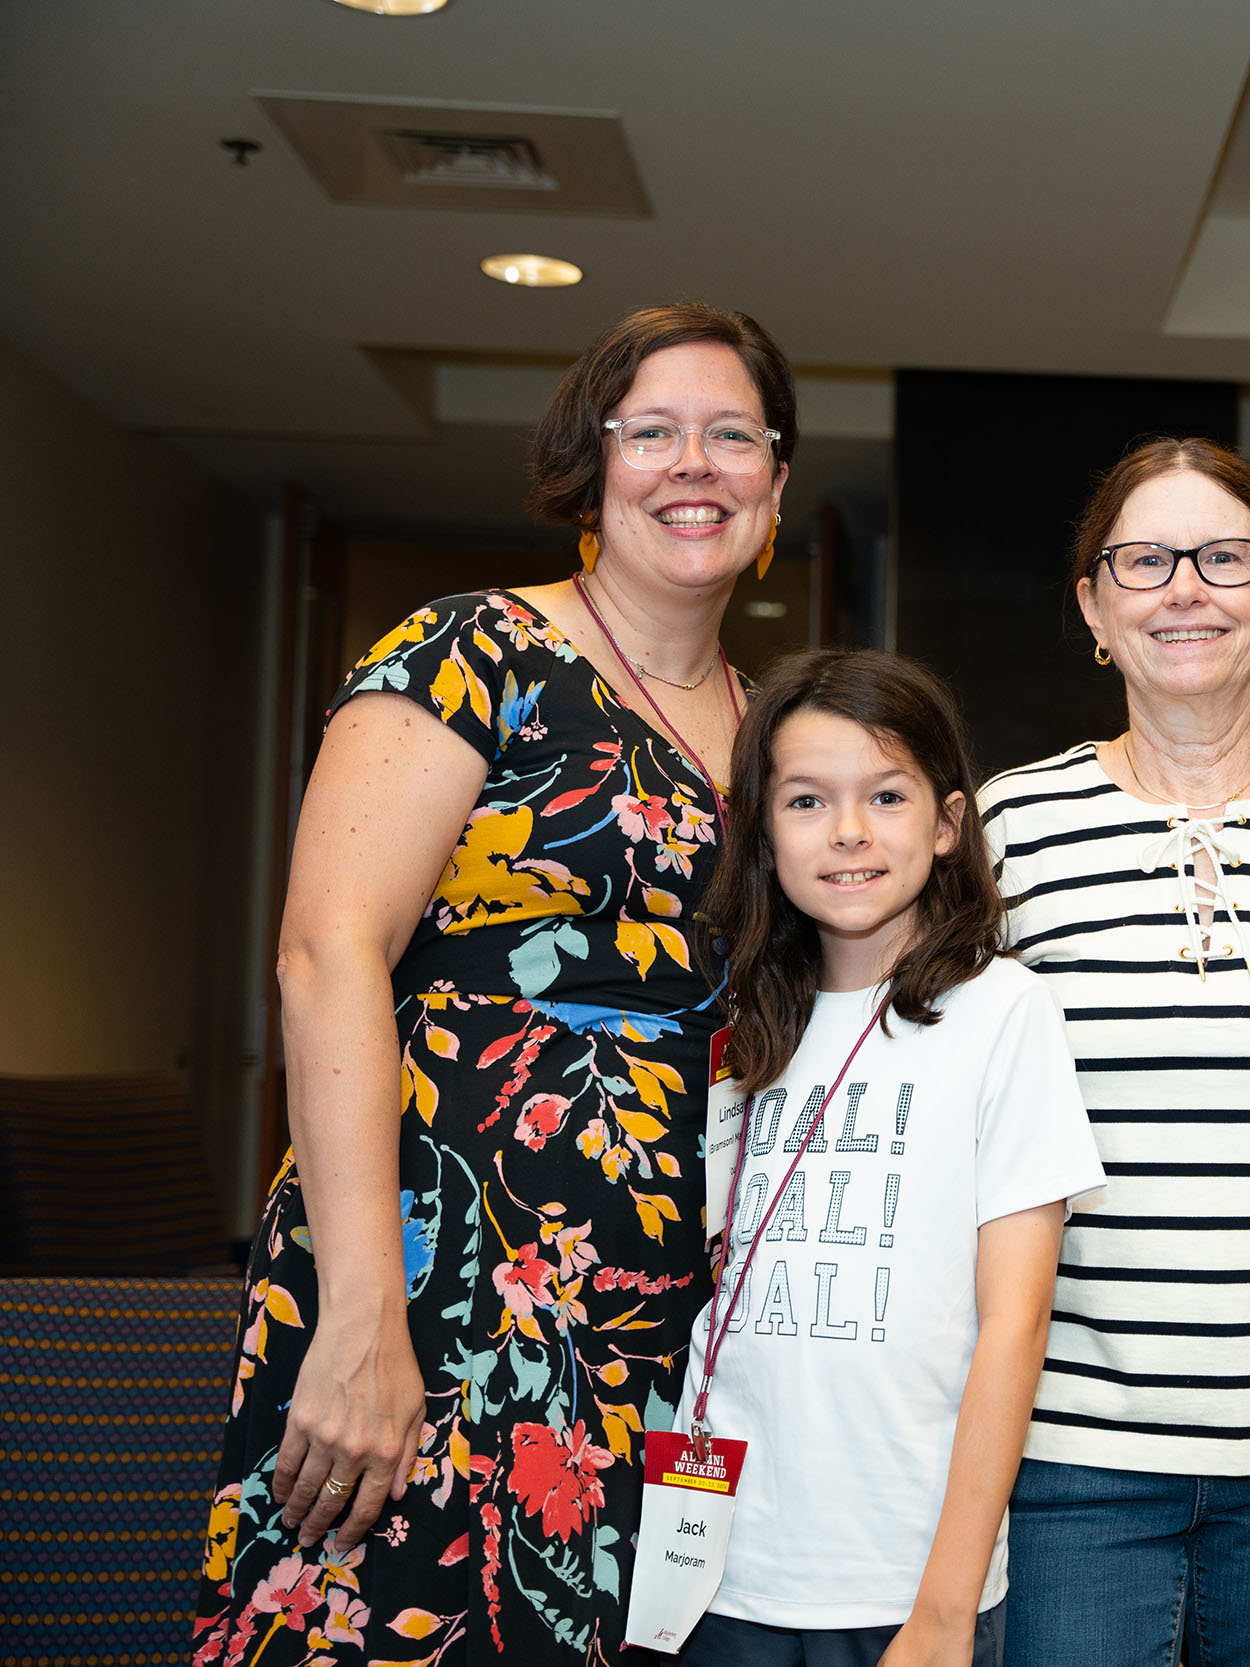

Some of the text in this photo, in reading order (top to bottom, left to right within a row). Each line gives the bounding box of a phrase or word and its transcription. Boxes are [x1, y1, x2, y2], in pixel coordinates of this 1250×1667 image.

[719, 1101, 746, 1123] Lindsa
[746, 1082, 914, 1157] OAL!
[734, 1171, 900, 1248] OAL!
[674, 1461, 727, 1479] WEEKEND
[666, 1475, 697, 1485] SEPTEMBER
[677, 1518, 707, 1537] Jack
[664, 1550, 706, 1568] Marjoram
